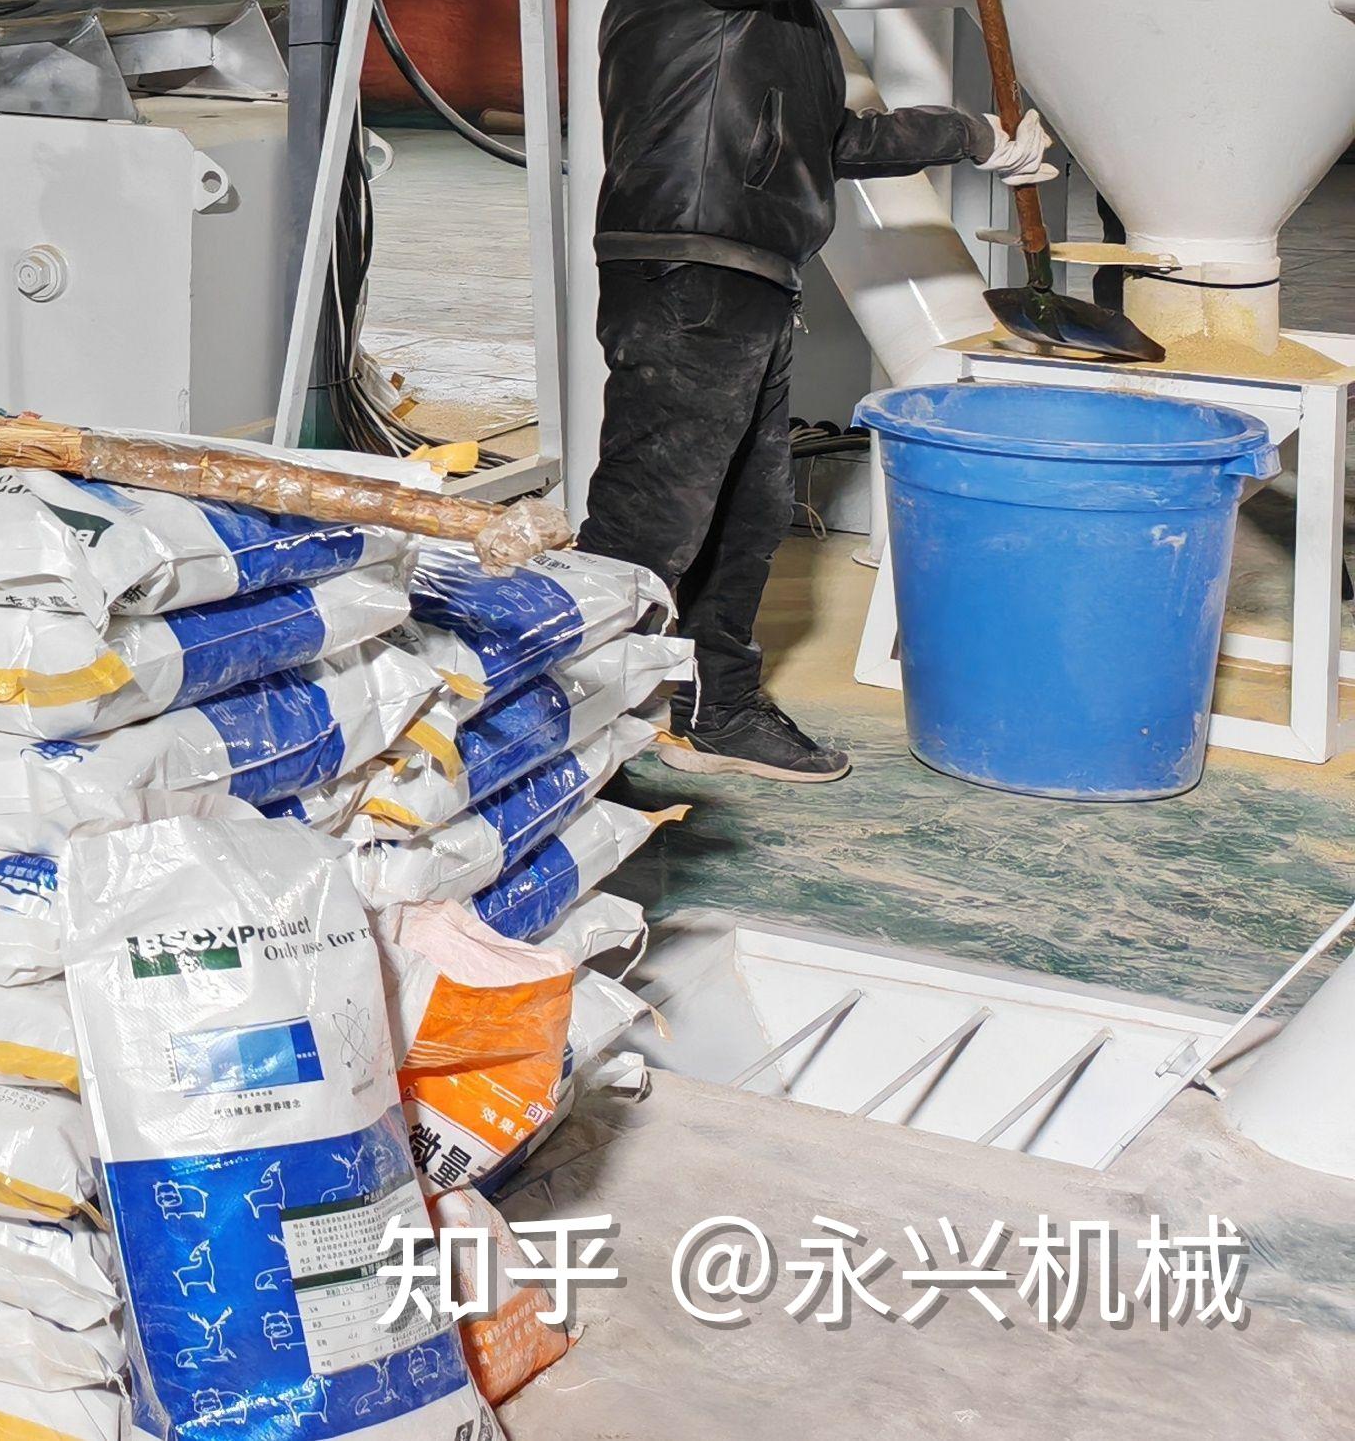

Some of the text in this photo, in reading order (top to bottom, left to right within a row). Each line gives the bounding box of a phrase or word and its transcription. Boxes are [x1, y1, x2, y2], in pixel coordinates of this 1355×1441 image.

[141, 916, 312, 957] BSCX Product
[263, 941, 299, 961] Only
[303, 941, 325, 955] use
[327, 930, 356, 948] for
[411, 1122, 489, 1190] 微量
